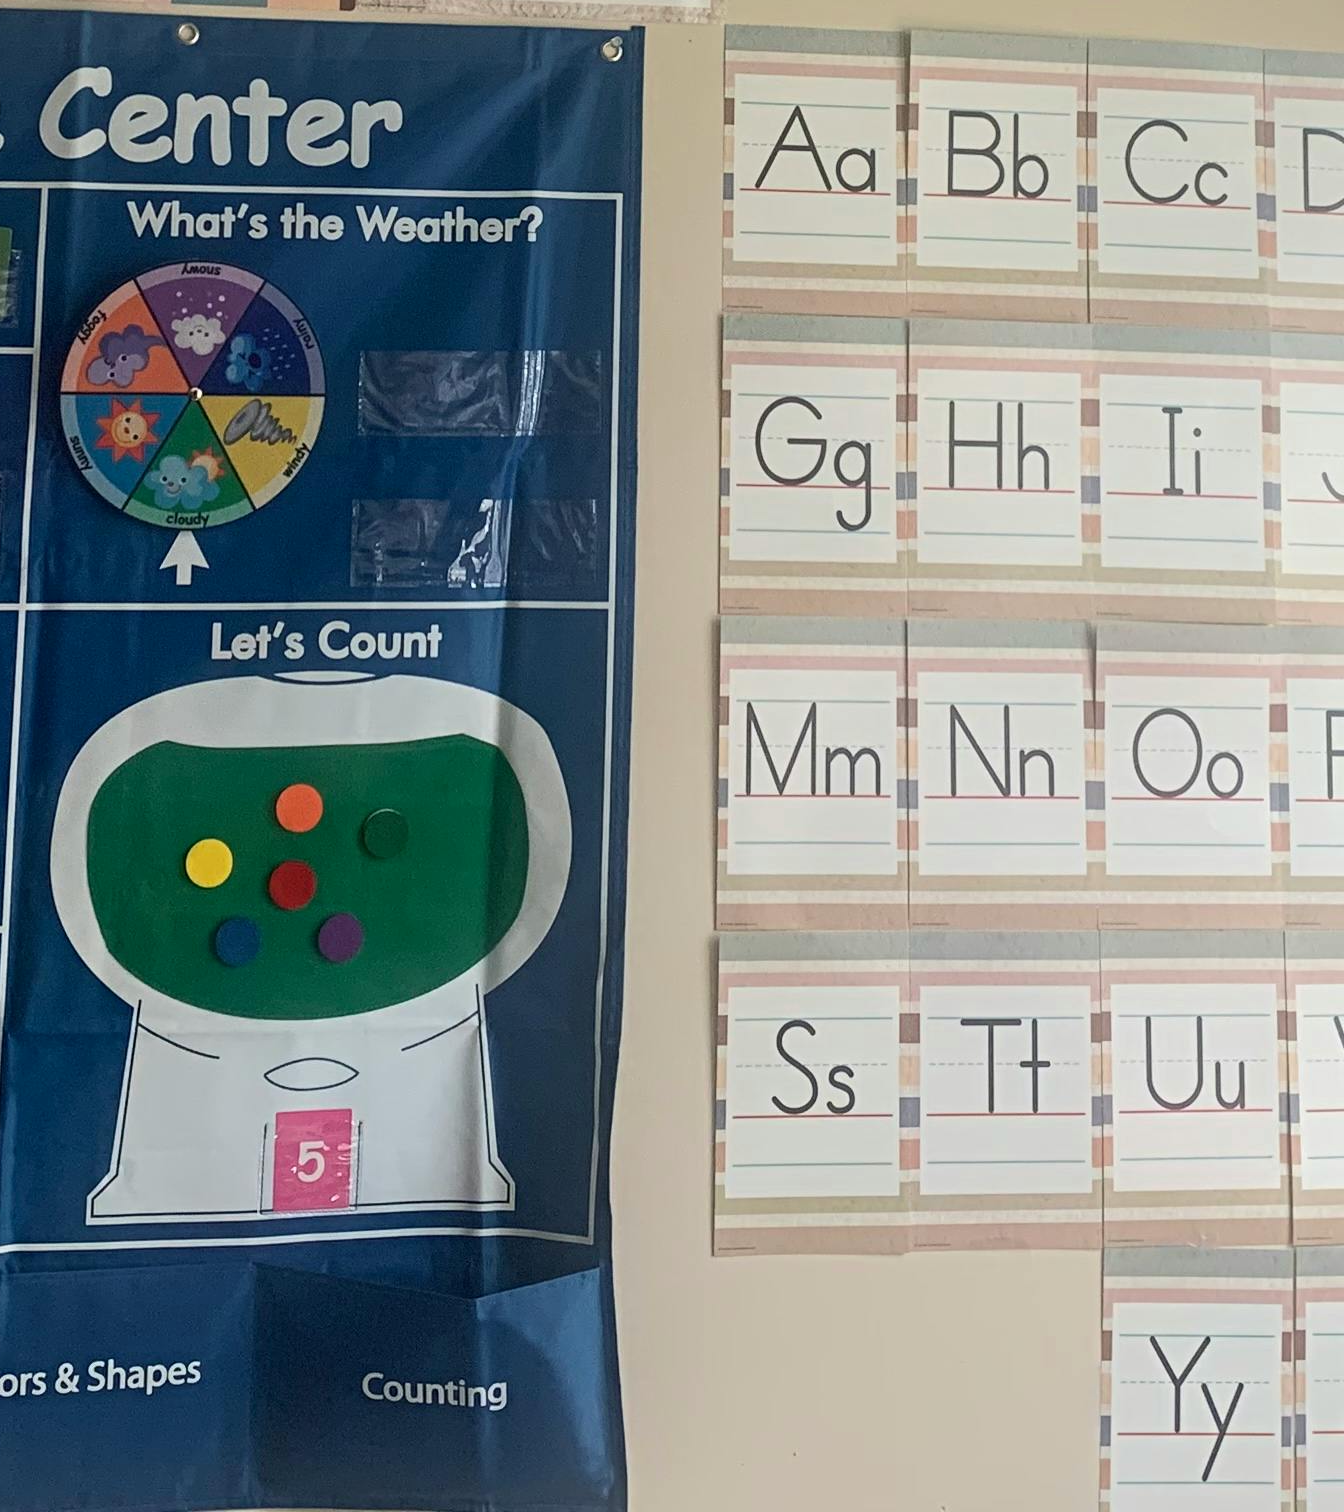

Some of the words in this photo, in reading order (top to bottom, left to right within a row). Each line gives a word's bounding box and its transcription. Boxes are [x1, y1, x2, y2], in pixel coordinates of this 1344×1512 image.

[39, 66, 403, 169] Center
[755, 106, 877, 193] Aa
[947, 110, 1049, 199] Bb
[1124, 119, 1229, 206] Cc
[126, 200, 268, 239] What's
[281, 203, 344, 241] the
[355, 205, 544, 244] Weather?
[181, 263, 221, 276] snowy
[282, 443, 310, 478] windy
[754, 396, 872, 532] Gg
[948, 400, 1050, 491] Hh
[1161, 406, 1203, 496] Ii
[165, 512, 210, 527] cloudy
[211, 621, 305, 660] Let's
[318, 620, 443, 660] Count
[745, 701, 882, 797] Mm
[949, 704, 1056, 798] Nn
[1132, 707, 1244, 798] Oo
[771, 1019, 857, 1115] Ss
[960, 1018, 1052, 1114] Tt
[1145, 1015, 1247, 1110] Uu
[297, 1140, 325, 1182] 5
[54, 1362, 80, 1394] &
[87, 1358, 201, 1395] Shapes
[362, 1372, 507, 1411] Counting
[1149, 1335, 1244, 1482] Yy
